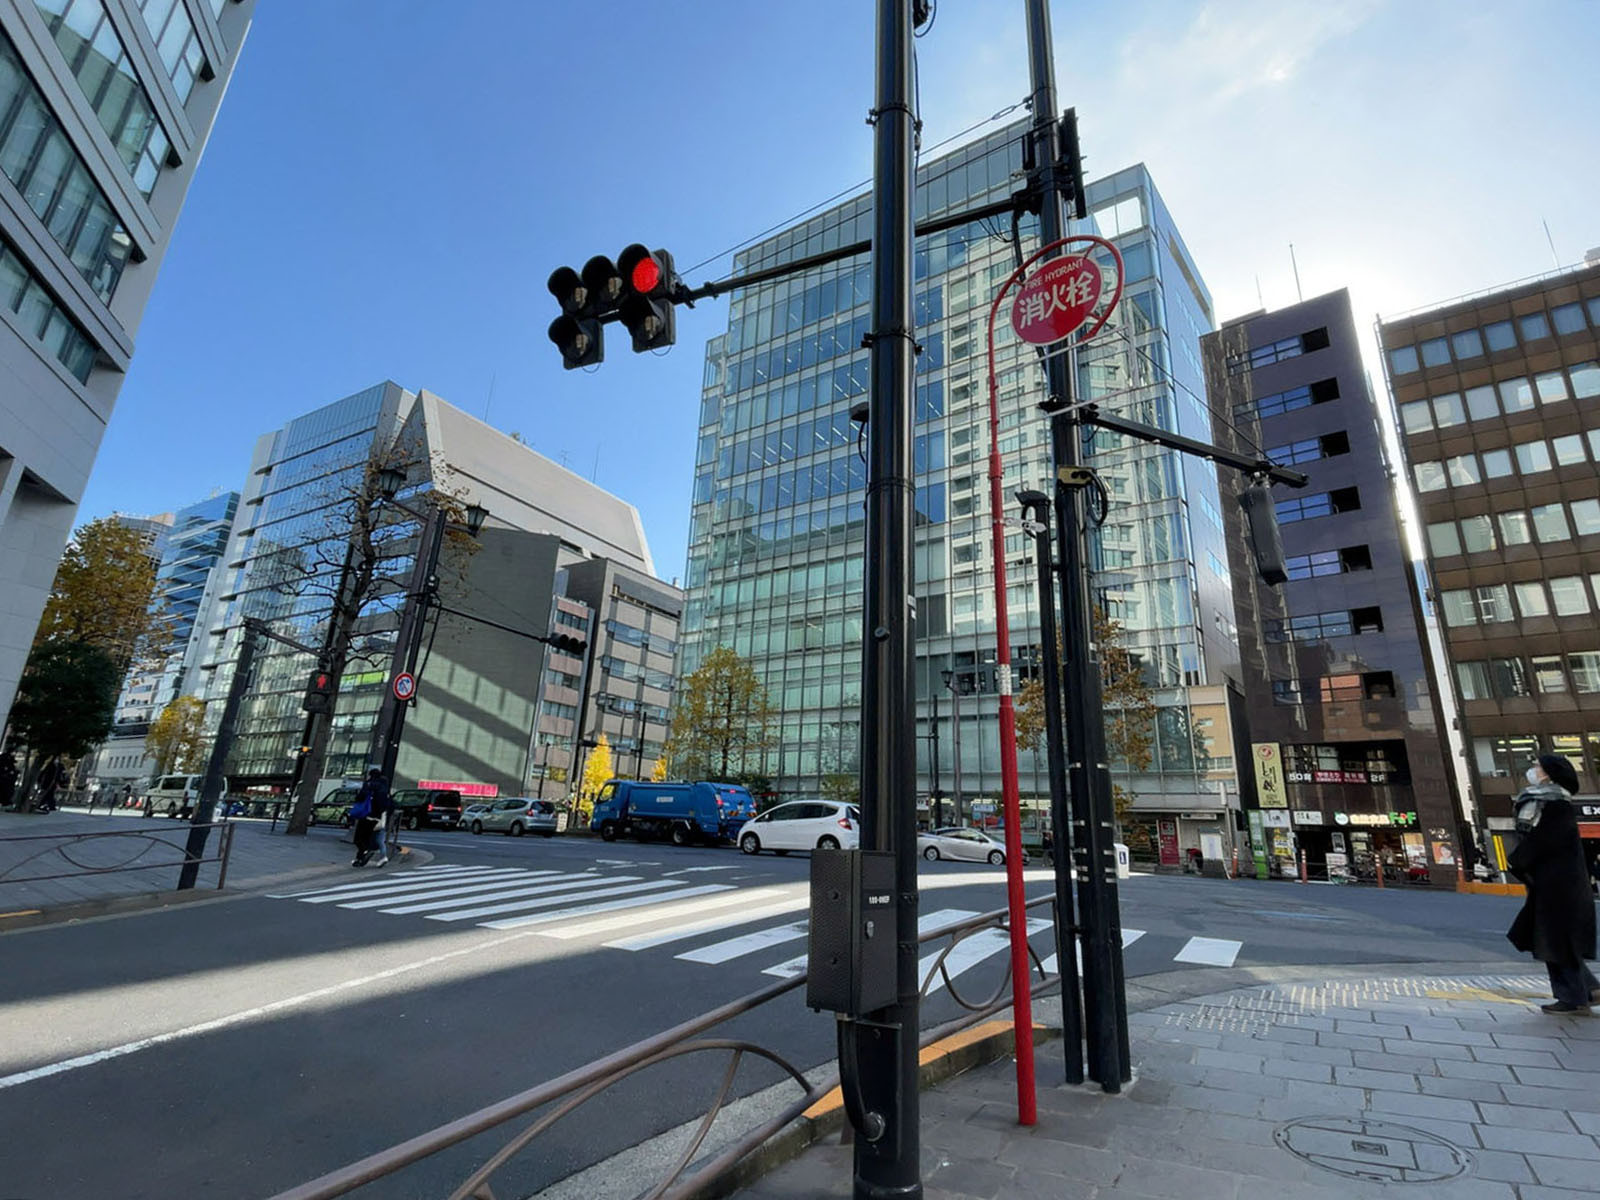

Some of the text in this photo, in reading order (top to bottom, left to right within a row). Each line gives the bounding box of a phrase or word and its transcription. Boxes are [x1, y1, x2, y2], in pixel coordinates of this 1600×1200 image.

[1024, 260, 1084, 291] FIRE HYDRANT
[1019, 271, 1095, 329] 消火栓
